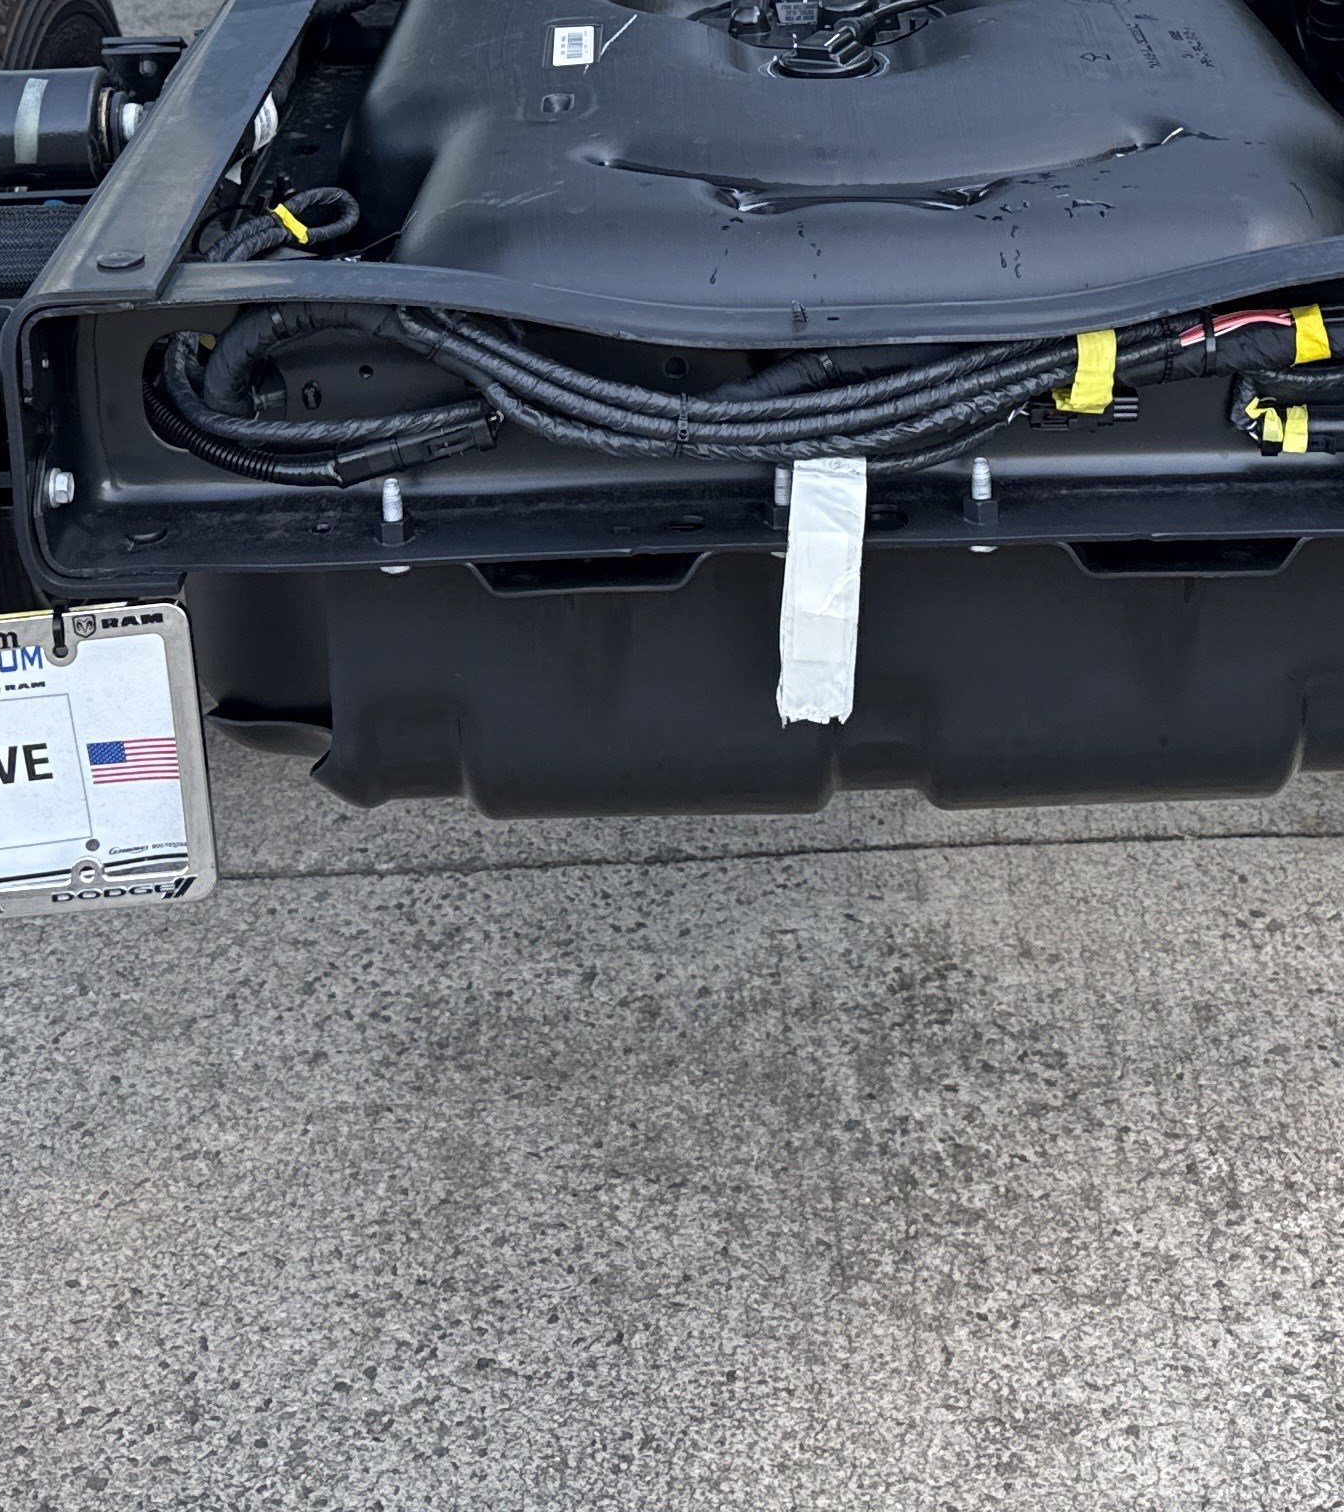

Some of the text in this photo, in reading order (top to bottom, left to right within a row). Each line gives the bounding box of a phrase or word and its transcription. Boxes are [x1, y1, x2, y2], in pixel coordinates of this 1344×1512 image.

[101, 612, 164, 629] RAM
[4, 681, 46, 691] RAM
[51, 882, 177, 902] DODGE
